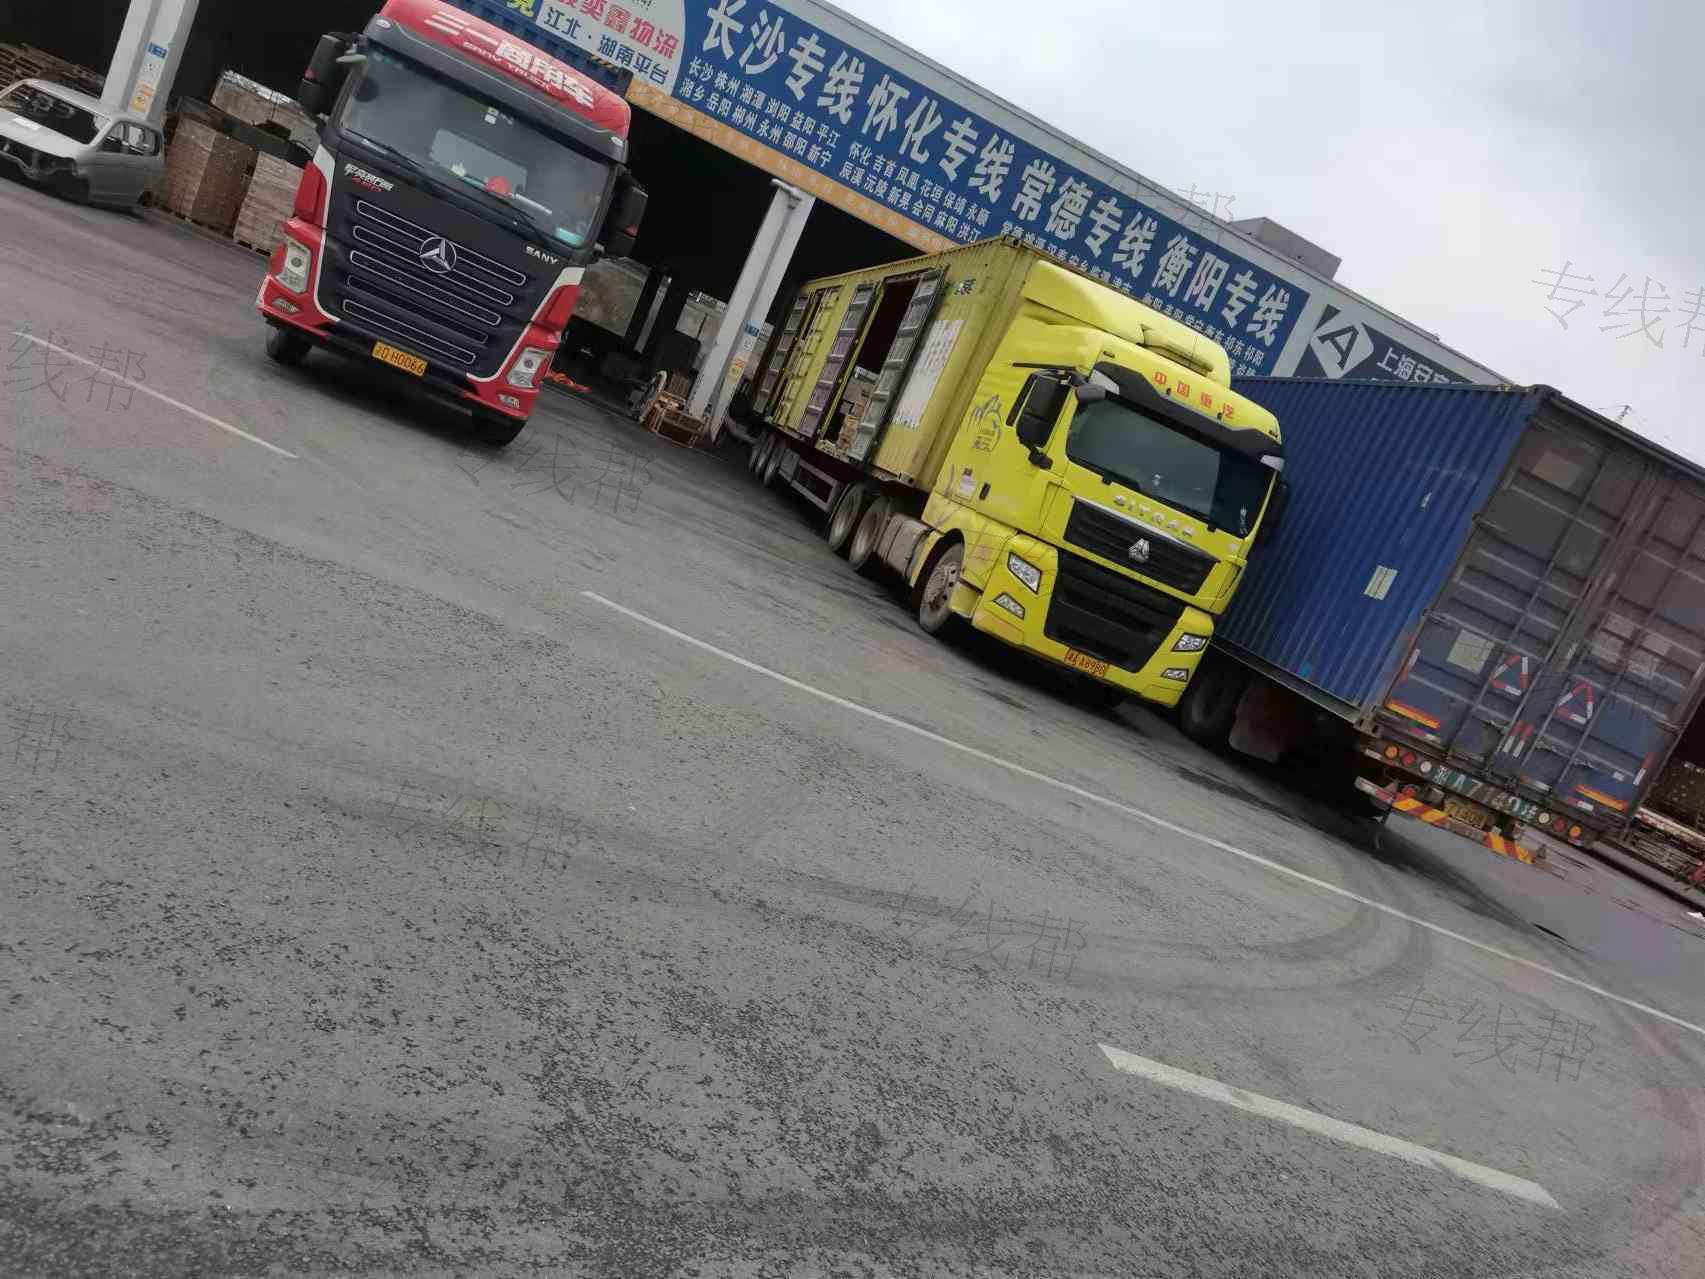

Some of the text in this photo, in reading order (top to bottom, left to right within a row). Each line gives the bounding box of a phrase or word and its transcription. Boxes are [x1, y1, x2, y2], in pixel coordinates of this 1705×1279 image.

[423, 11, 595, 110] 三一商用车
[689, 56, 713, 81] 长沙
[790, 111, 816, 136] 益阳
[817, 124, 840, 147] 平江
[707, 93, 732, 117] 岳阳
[757, 119, 783, 144] 永州
[783, 132, 808, 156] 邵阳
[807, 144, 832, 167] 新宁
[703, 0, 1291, 347] 长沙专线 怀化专线 常德专线 衡阳专线
[849, 142, 872, 165] 怀化
[873, 155, 896, 177] 吉首
[896, 167, 920, 190] 凤凰
[921, 179, 944, 202] 花垣
[912, 199, 935, 222] 会同
[526, 245, 559, 265] SANY
